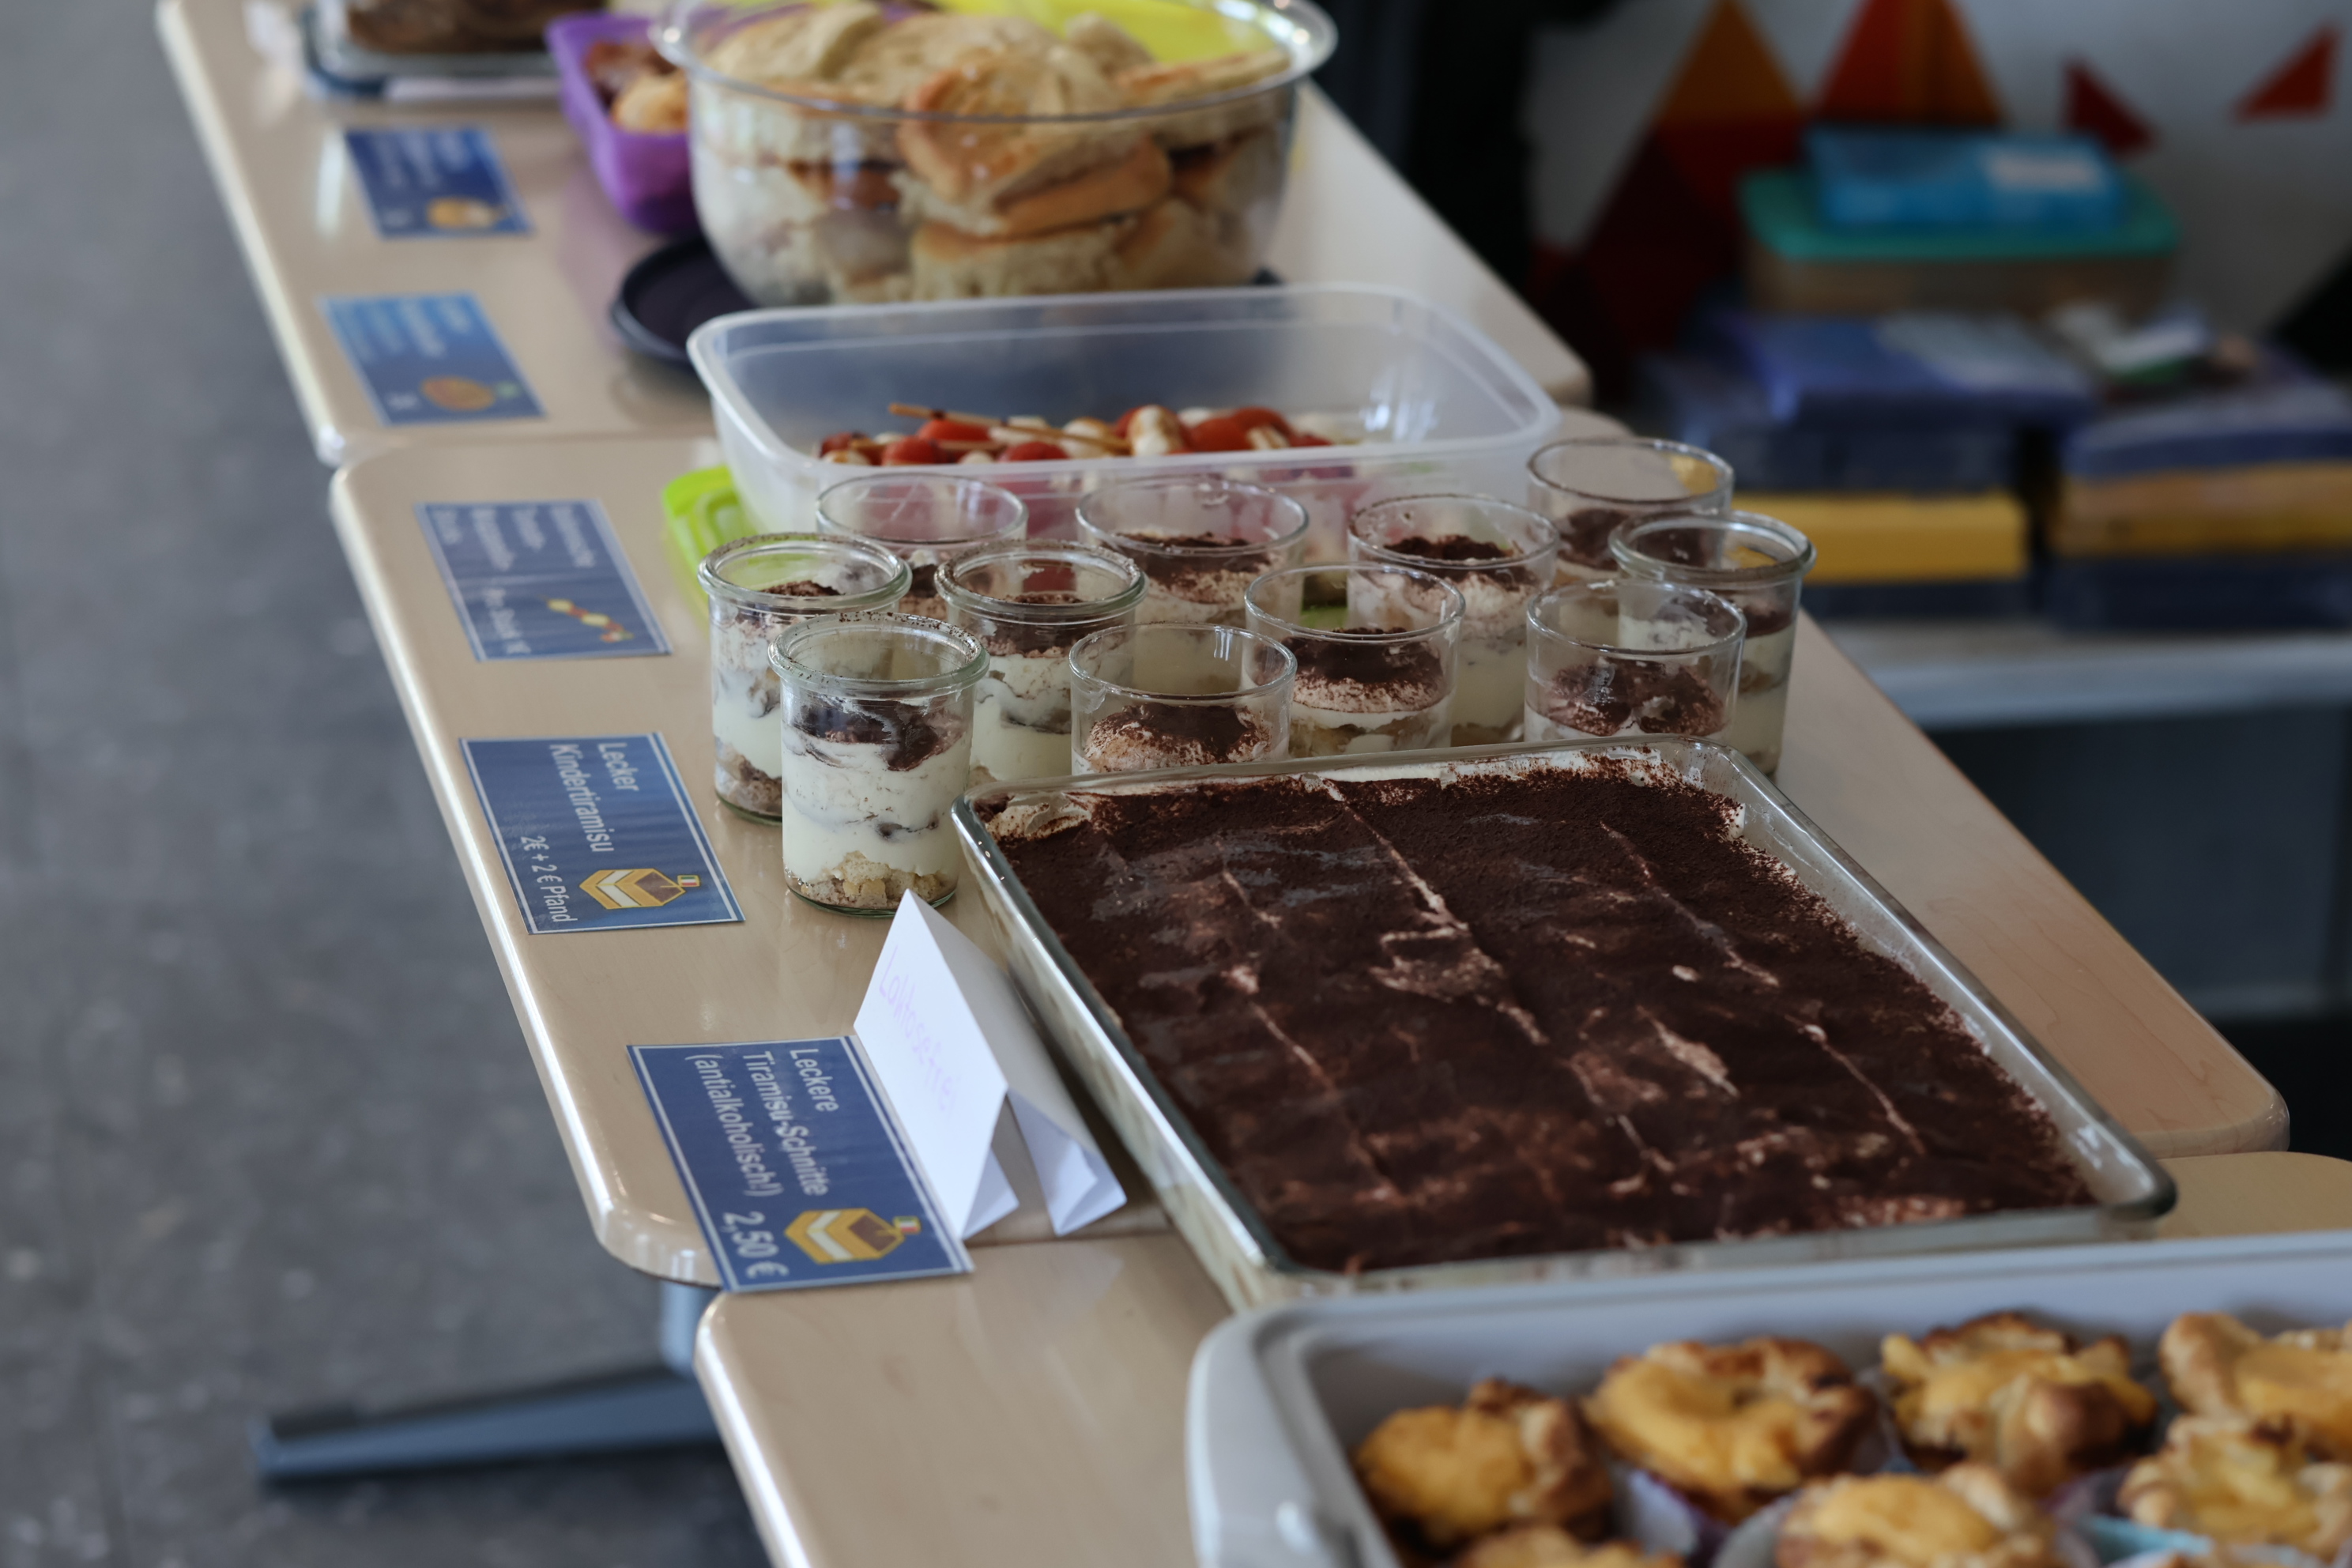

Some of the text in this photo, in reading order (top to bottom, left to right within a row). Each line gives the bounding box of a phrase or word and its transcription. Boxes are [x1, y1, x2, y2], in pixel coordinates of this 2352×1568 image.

[598, 743, 639, 791] Lecker
[549, 744, 614, 852] Kindertiramisu
[521, 835, 549, 851] 2€
[531, 865, 557, 873] 2
[537, 873, 563, 884] €
[541, 885, 578, 922] Pfand
[790, 1048, 839, 1112] Leckere
[684, 1054, 784, 1197] (antialkoholisch!)
[743, 1051, 829, 1196] Tiramisu-Schnitte
[720, 1211, 790, 1279] 2,50 €
